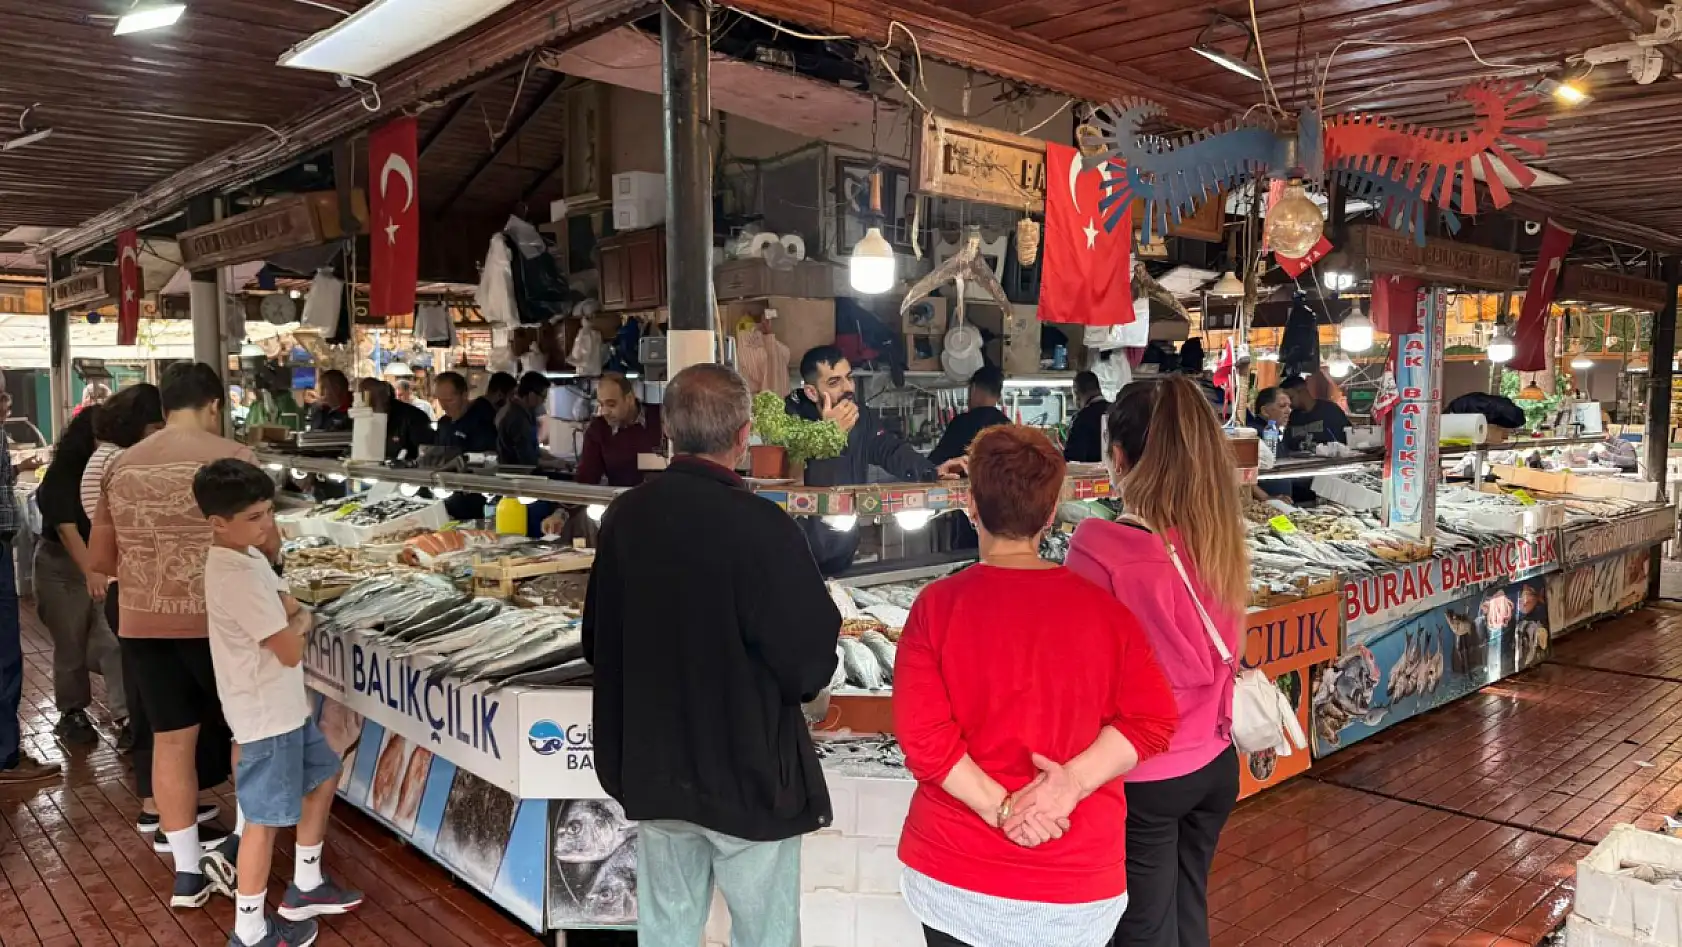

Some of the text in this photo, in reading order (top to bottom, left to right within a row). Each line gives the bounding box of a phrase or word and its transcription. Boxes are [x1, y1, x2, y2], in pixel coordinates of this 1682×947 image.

[1344, 562, 1434, 621] BURAK
[1441, 533, 1556, 592] BALIKÇILIK
[353, 644, 501, 760] BALIKÇILIK
